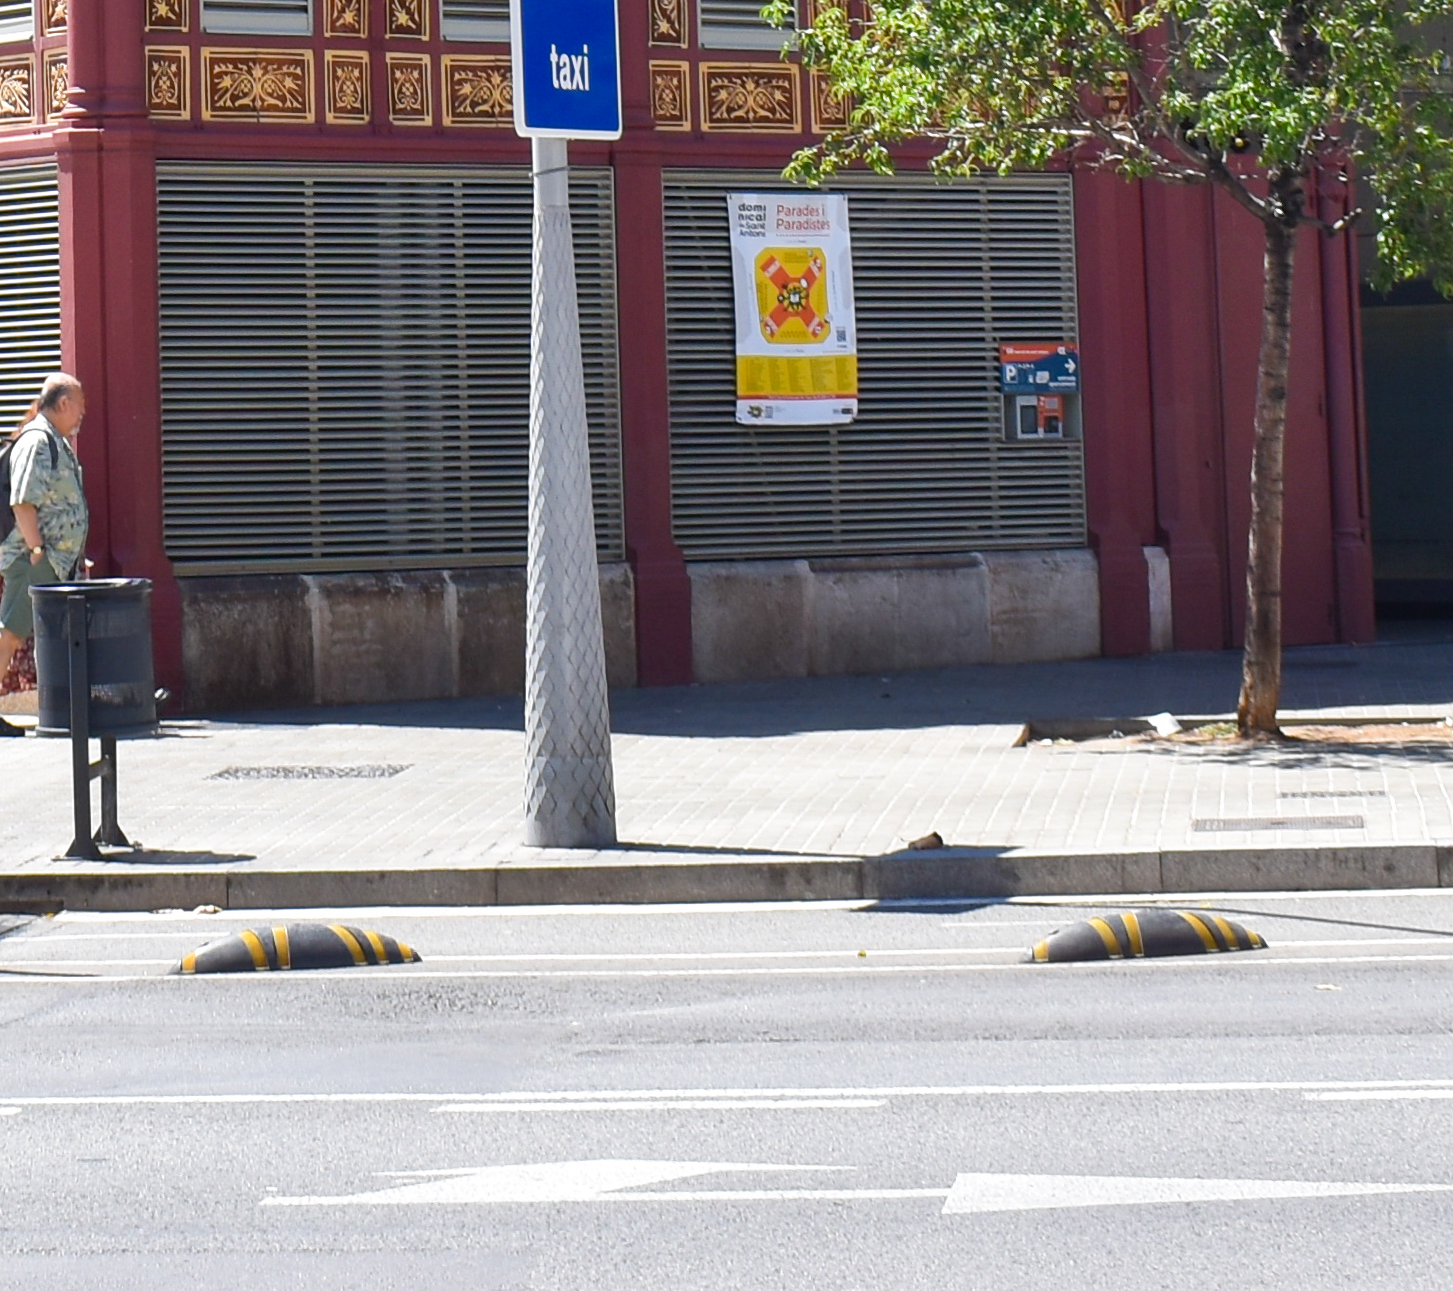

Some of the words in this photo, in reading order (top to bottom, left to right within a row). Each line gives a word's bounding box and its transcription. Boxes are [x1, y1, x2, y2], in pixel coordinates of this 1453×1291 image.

[549, 43, 590, 92] taxi
[777, 204, 820, 217] Parades
[776, 218, 831, 231] Paradistes
